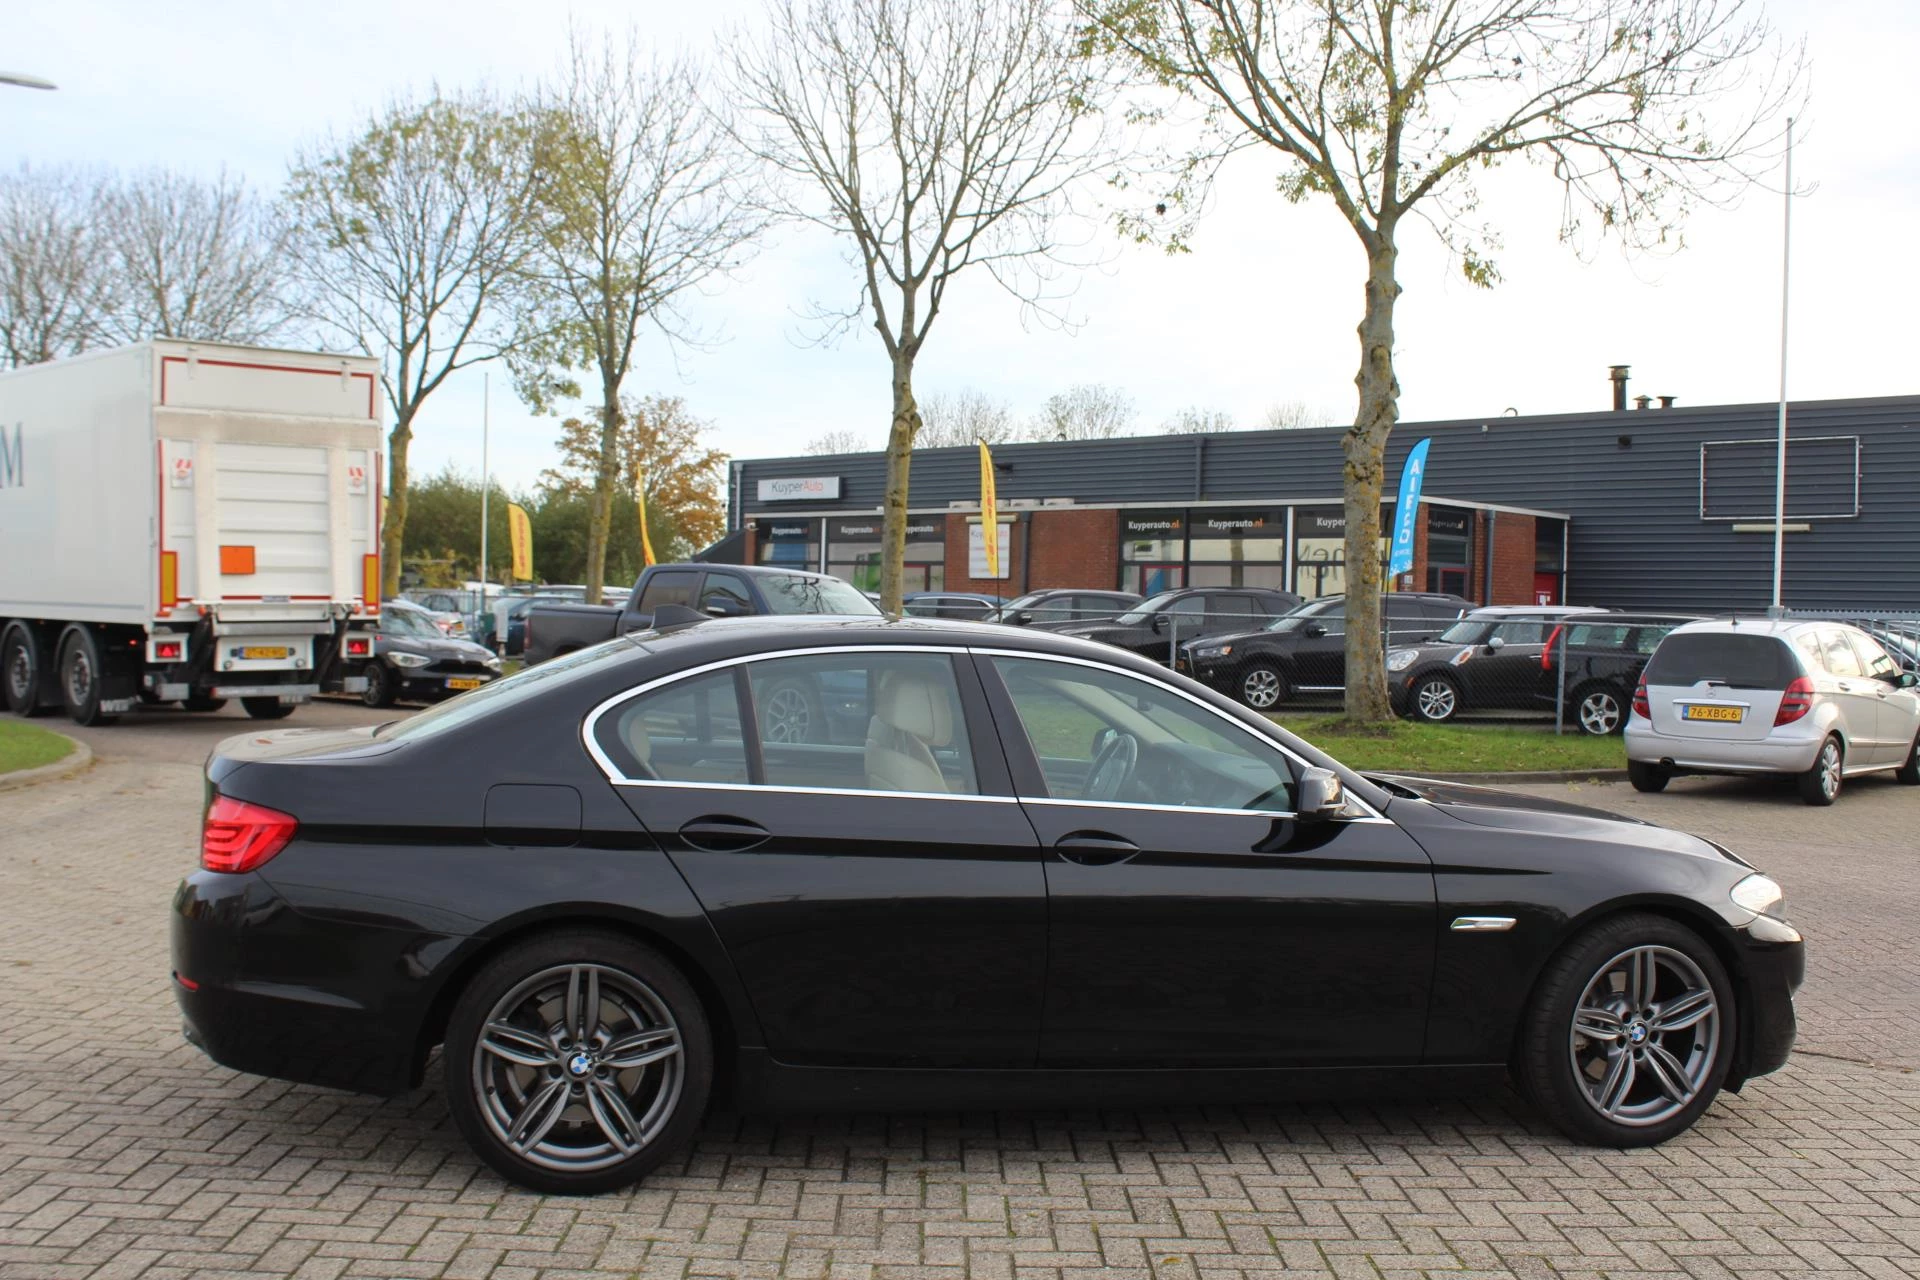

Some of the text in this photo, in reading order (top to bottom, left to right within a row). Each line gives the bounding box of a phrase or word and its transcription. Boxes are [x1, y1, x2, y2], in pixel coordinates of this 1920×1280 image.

[771, 480, 824, 494] KuyperAuto
[905, 524, 942, 534] yperauto.nl
[1128, 519, 1180, 531] Kuyperauto.nl
[1208, 517, 1264, 531] Kuyperauto.nl
[1690, 707, 1737, 719] 76-XBG-6
